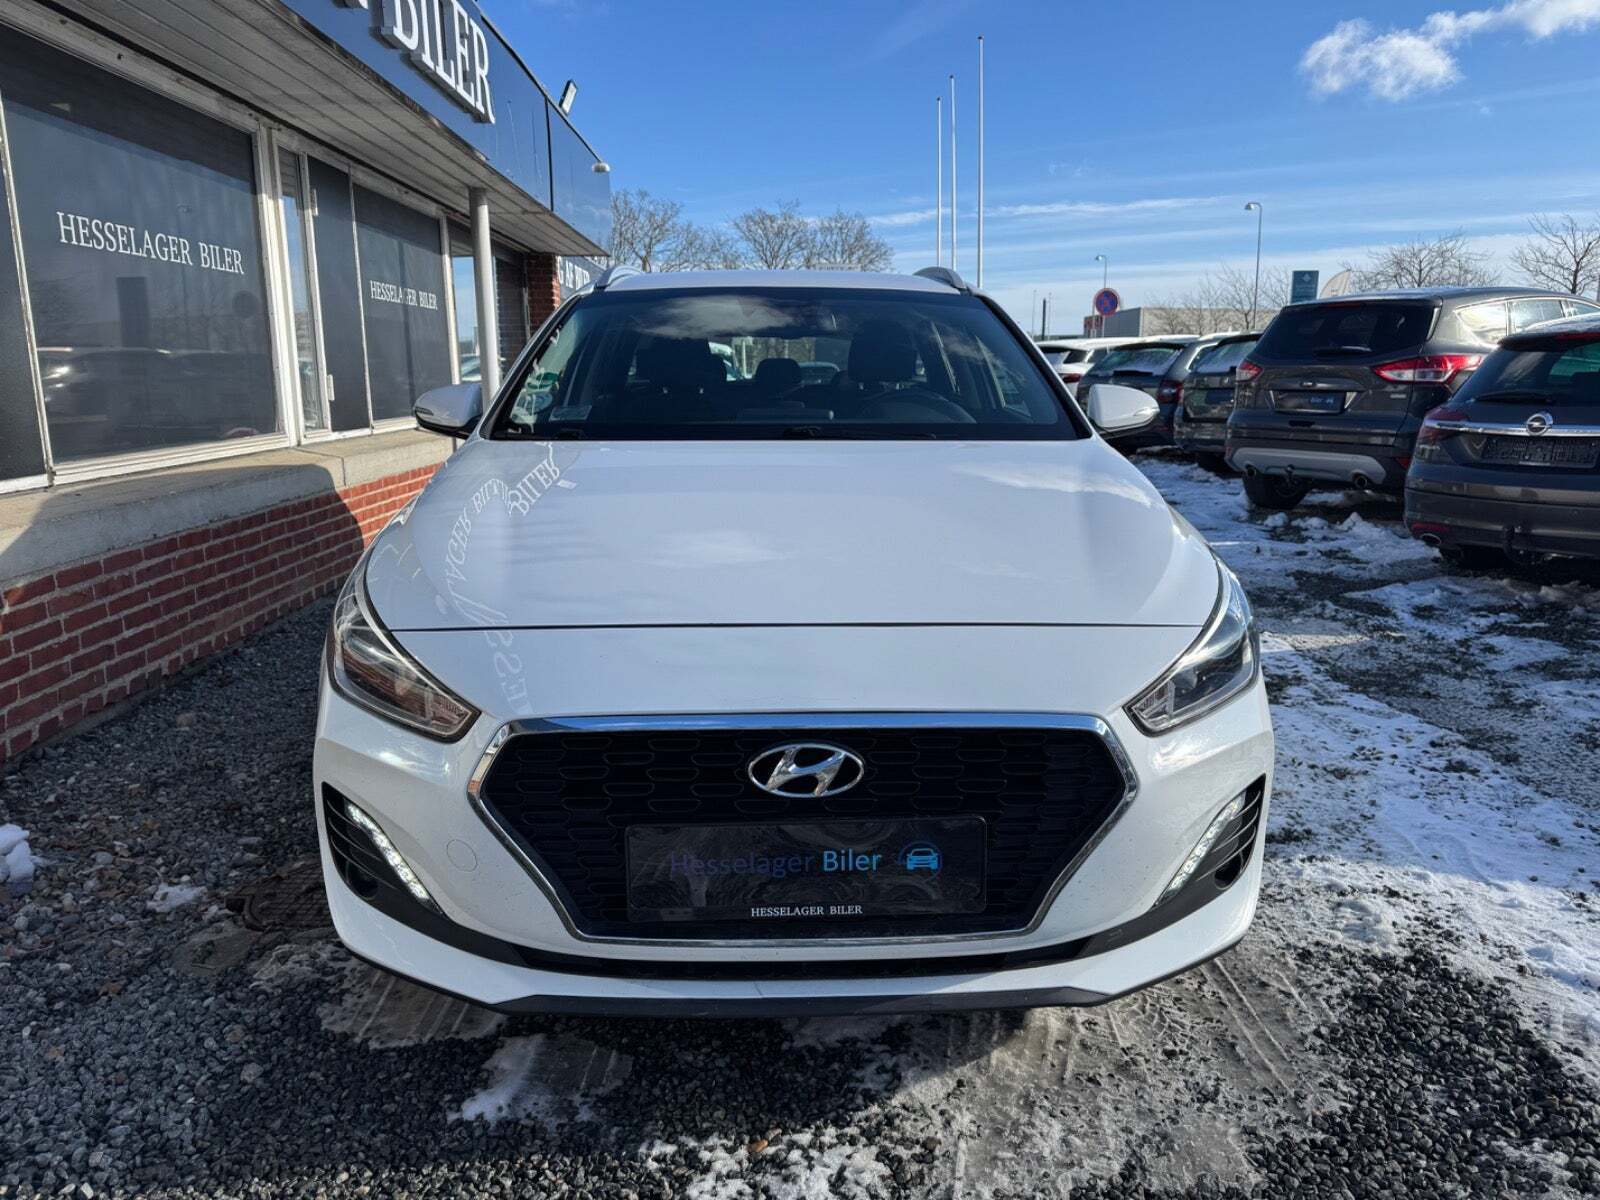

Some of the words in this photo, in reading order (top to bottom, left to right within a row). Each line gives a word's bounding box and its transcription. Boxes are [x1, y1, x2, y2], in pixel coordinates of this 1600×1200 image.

[56, 211, 194, 266] HESSELAGER
[198, 241, 245, 275] BILER
[671, 853, 814, 877] Hesselager
[823, 850, 881, 871] Biler
[751, 906, 825, 918] HESSELAGER
[829, 904, 863, 915] BILER
